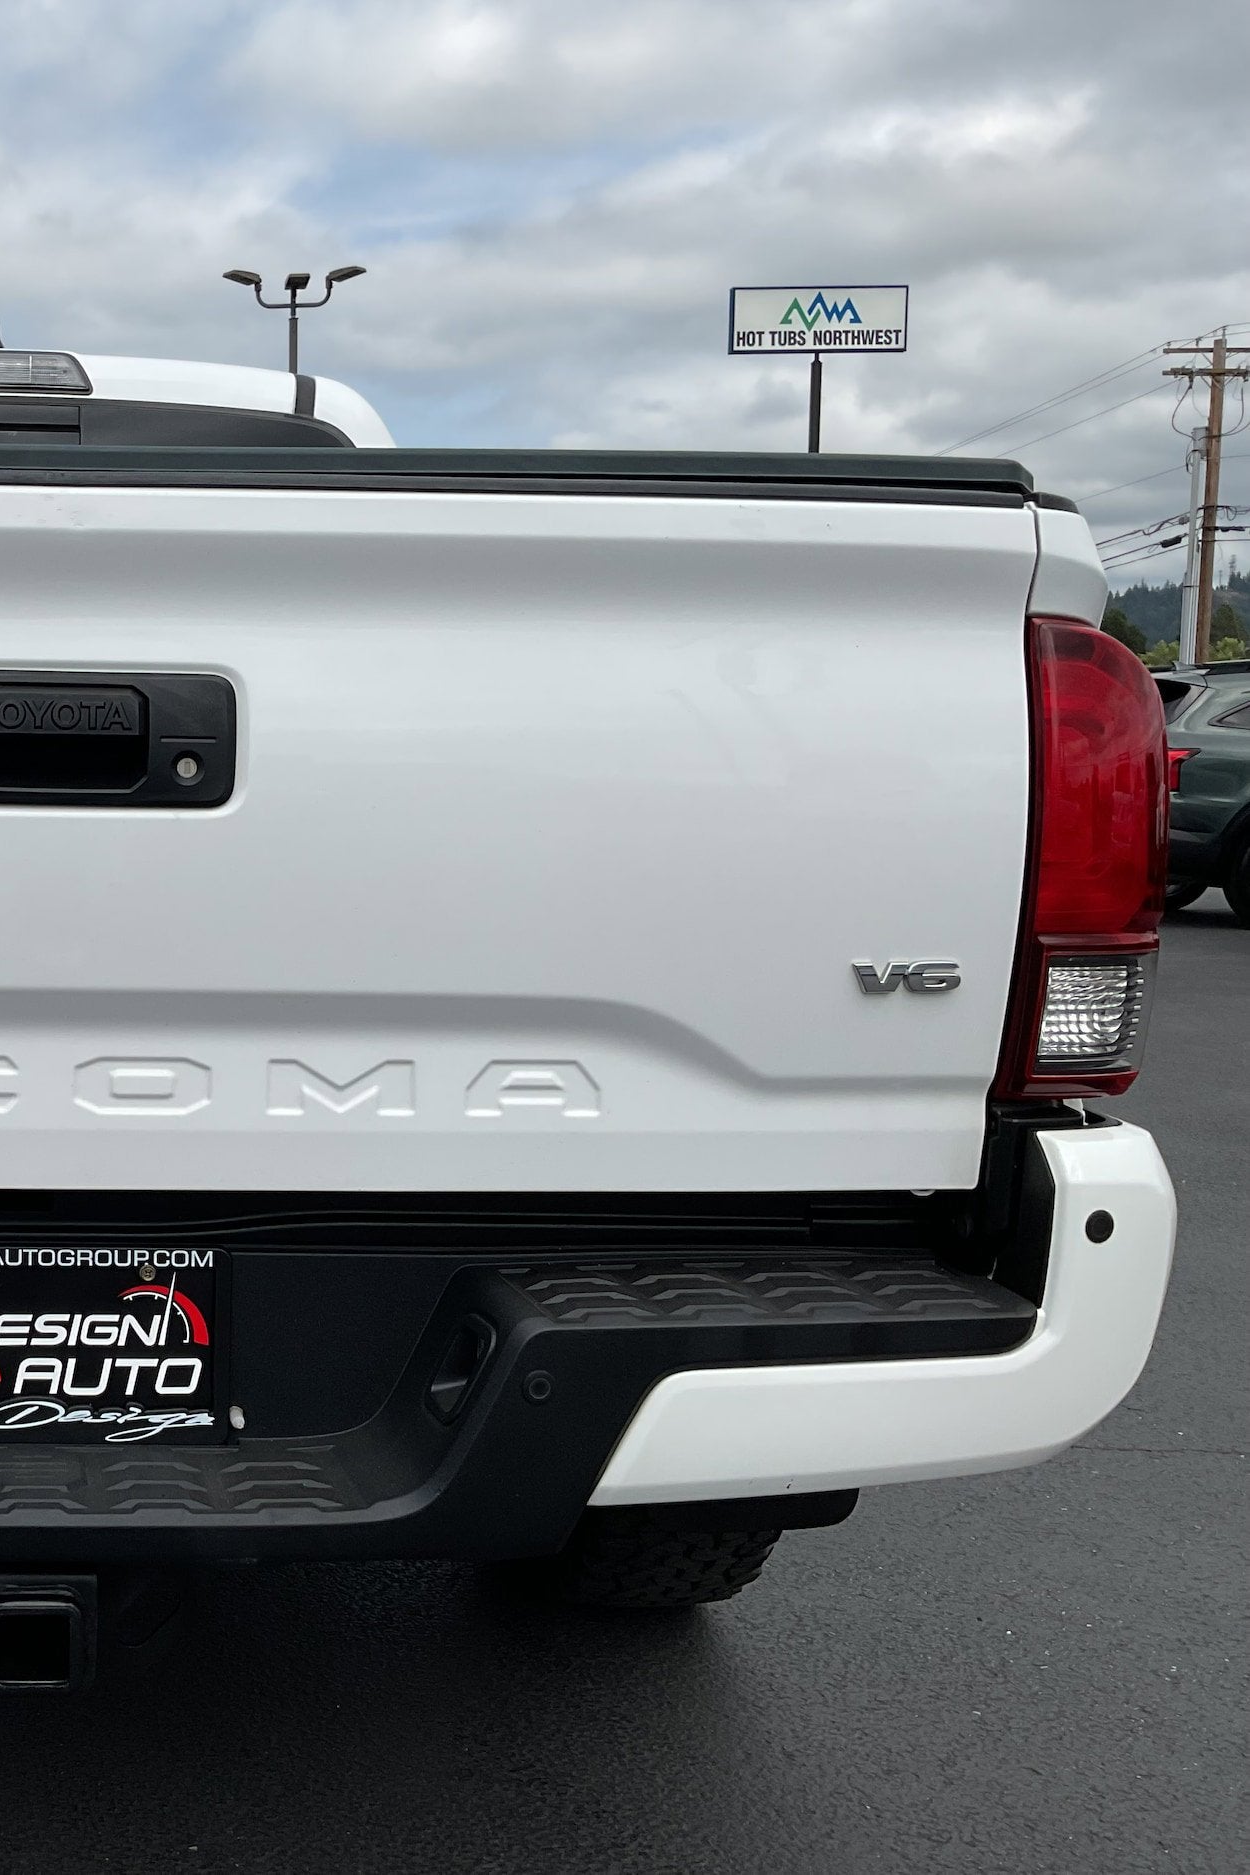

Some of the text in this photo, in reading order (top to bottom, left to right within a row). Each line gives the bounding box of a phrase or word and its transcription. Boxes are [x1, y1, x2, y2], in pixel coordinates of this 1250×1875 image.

[736, 329, 902, 347] HOT TUBS NORTHWEST
[851, 960, 961, 994] V6
[12, 1357, 203, 1397] AUTO
